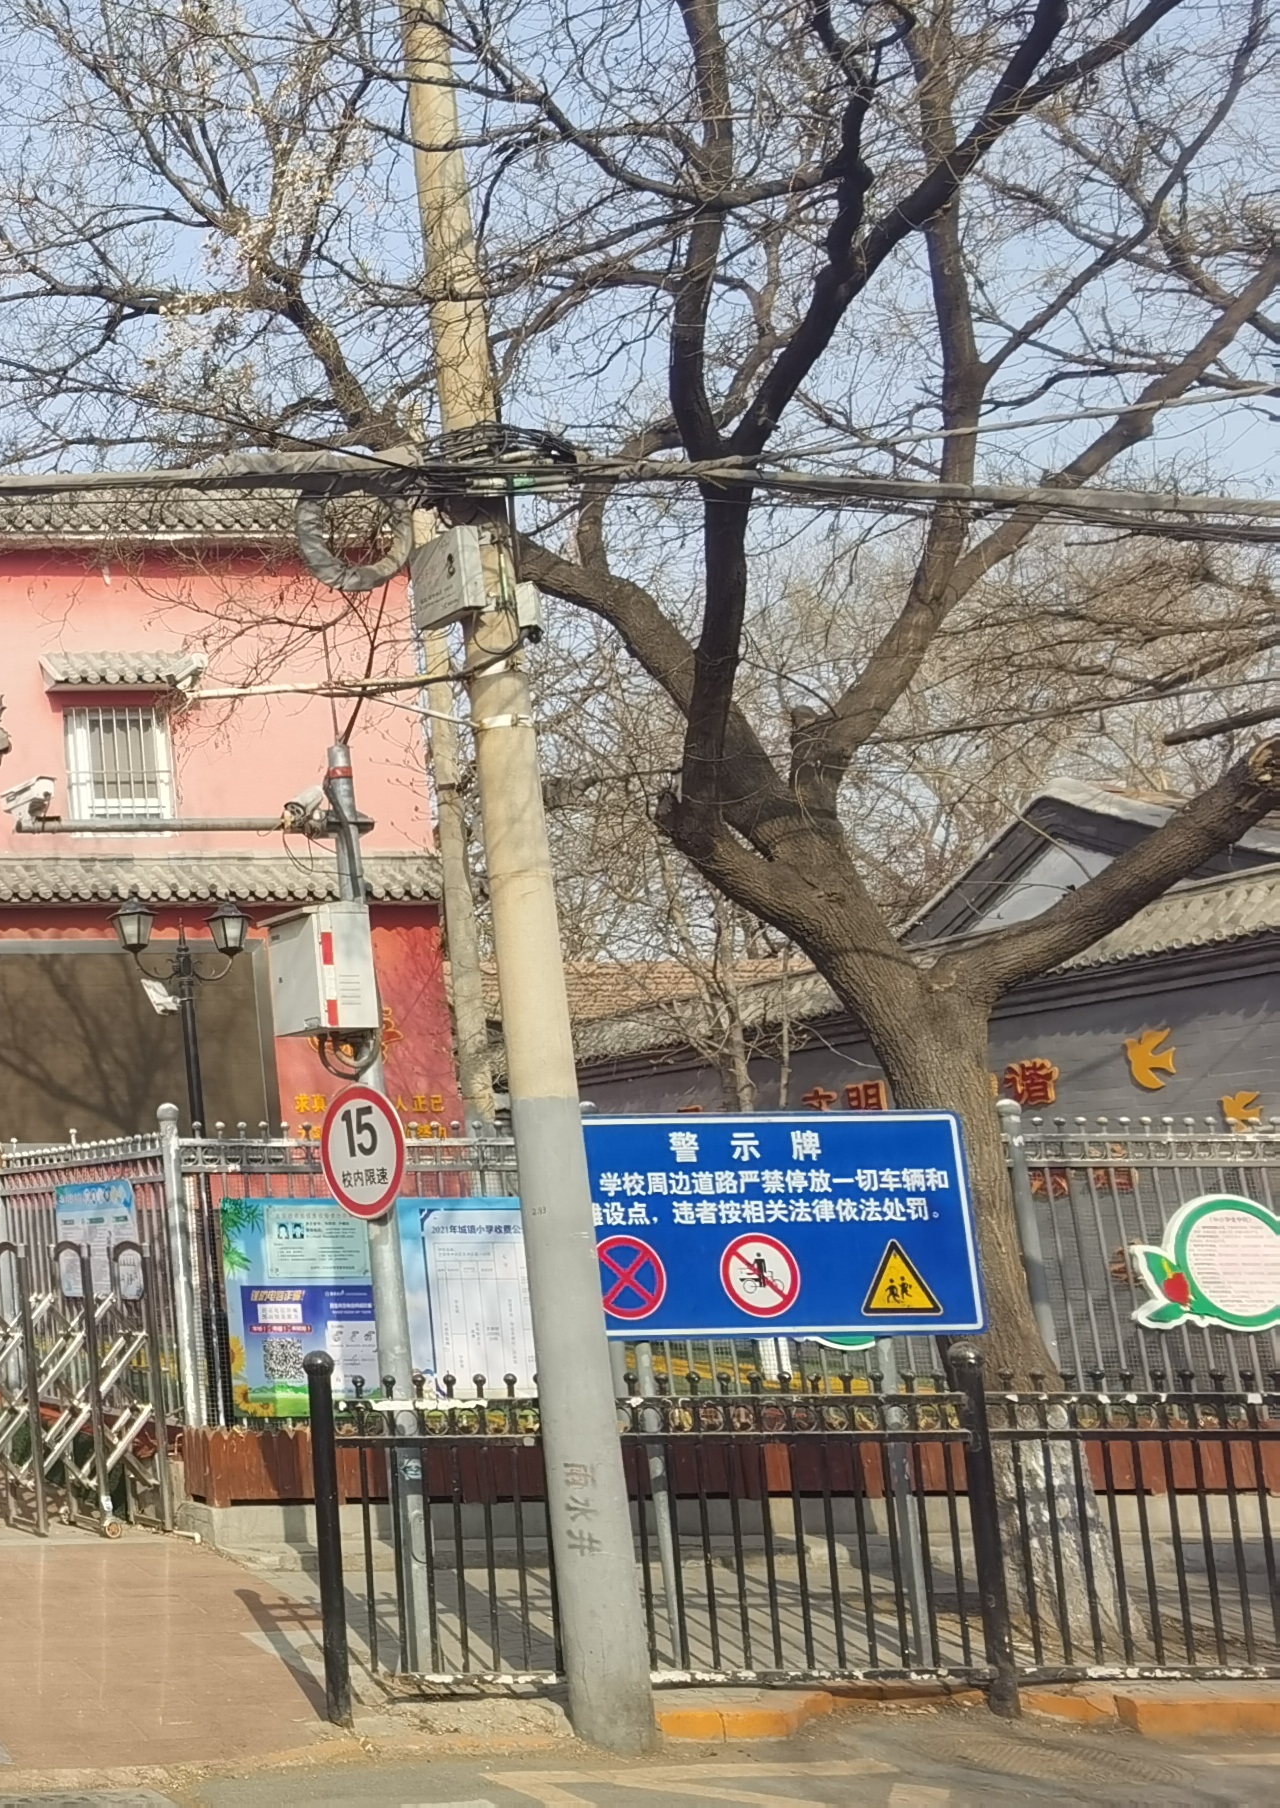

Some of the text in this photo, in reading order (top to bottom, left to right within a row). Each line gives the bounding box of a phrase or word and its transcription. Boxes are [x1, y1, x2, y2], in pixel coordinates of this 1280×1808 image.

[294, 1092, 328, 1113] 求真
[341, 1105, 378, 1158] 15
[668, 1130, 822, 1163] 警示牌
[341, 1166, 389, 1189] 校内限速
[599, 1167, 950, 1197] 学校周边道路严禁停放一切车辆和
[431, 1224, 522, 1235] 2021年城镇小学收费公
